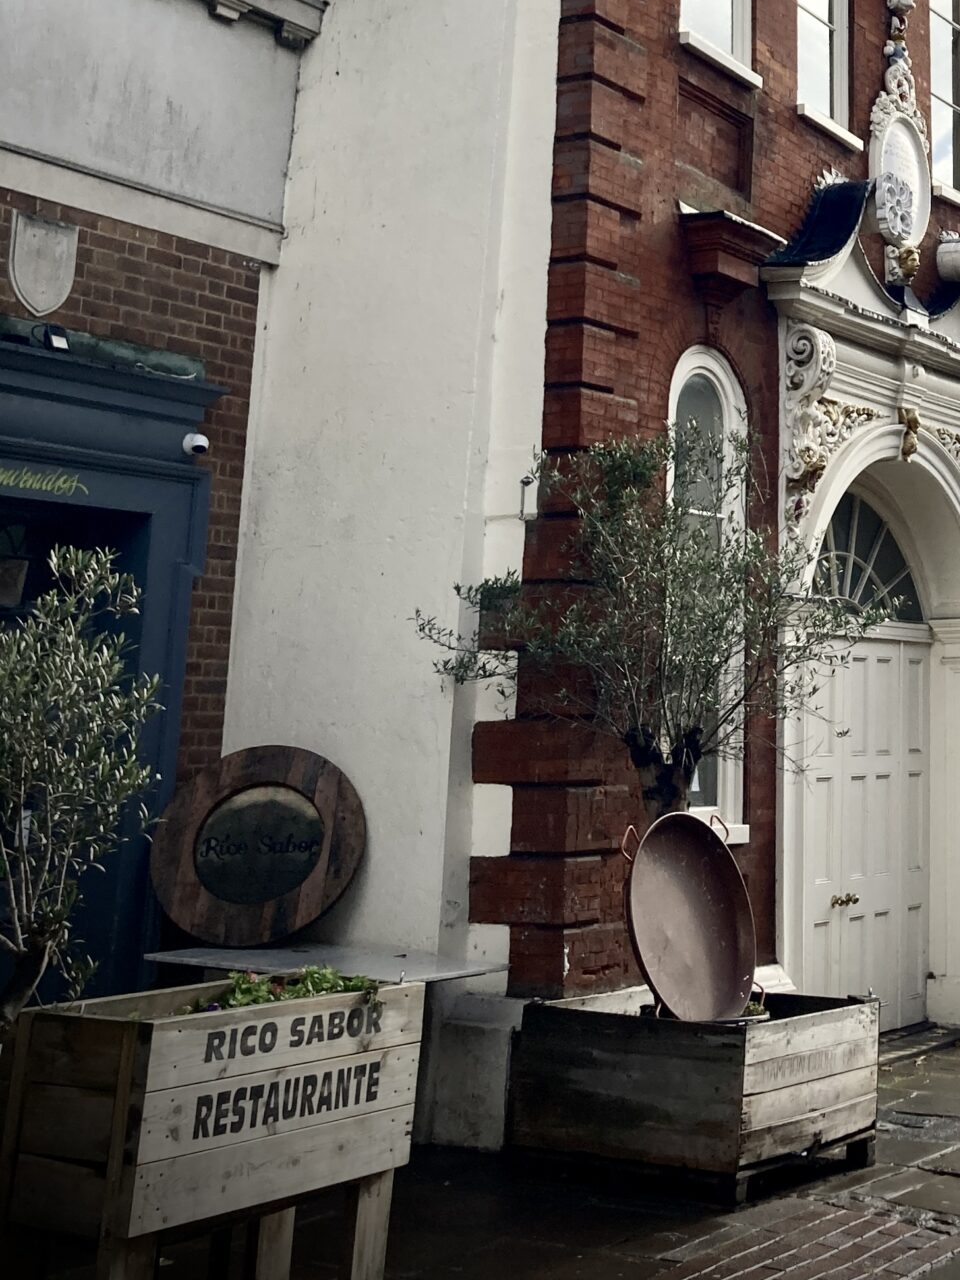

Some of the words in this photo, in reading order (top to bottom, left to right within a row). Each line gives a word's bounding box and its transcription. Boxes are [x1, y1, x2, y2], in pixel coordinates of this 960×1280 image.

[200, 833, 249, 861] Rico
[256, 832, 320, 856] Sabor
[204, 1021, 279, 1063] RICO
[289, 1006, 384, 1048] SABOR
[192, 1060, 382, 1140] RESTAURANTE
